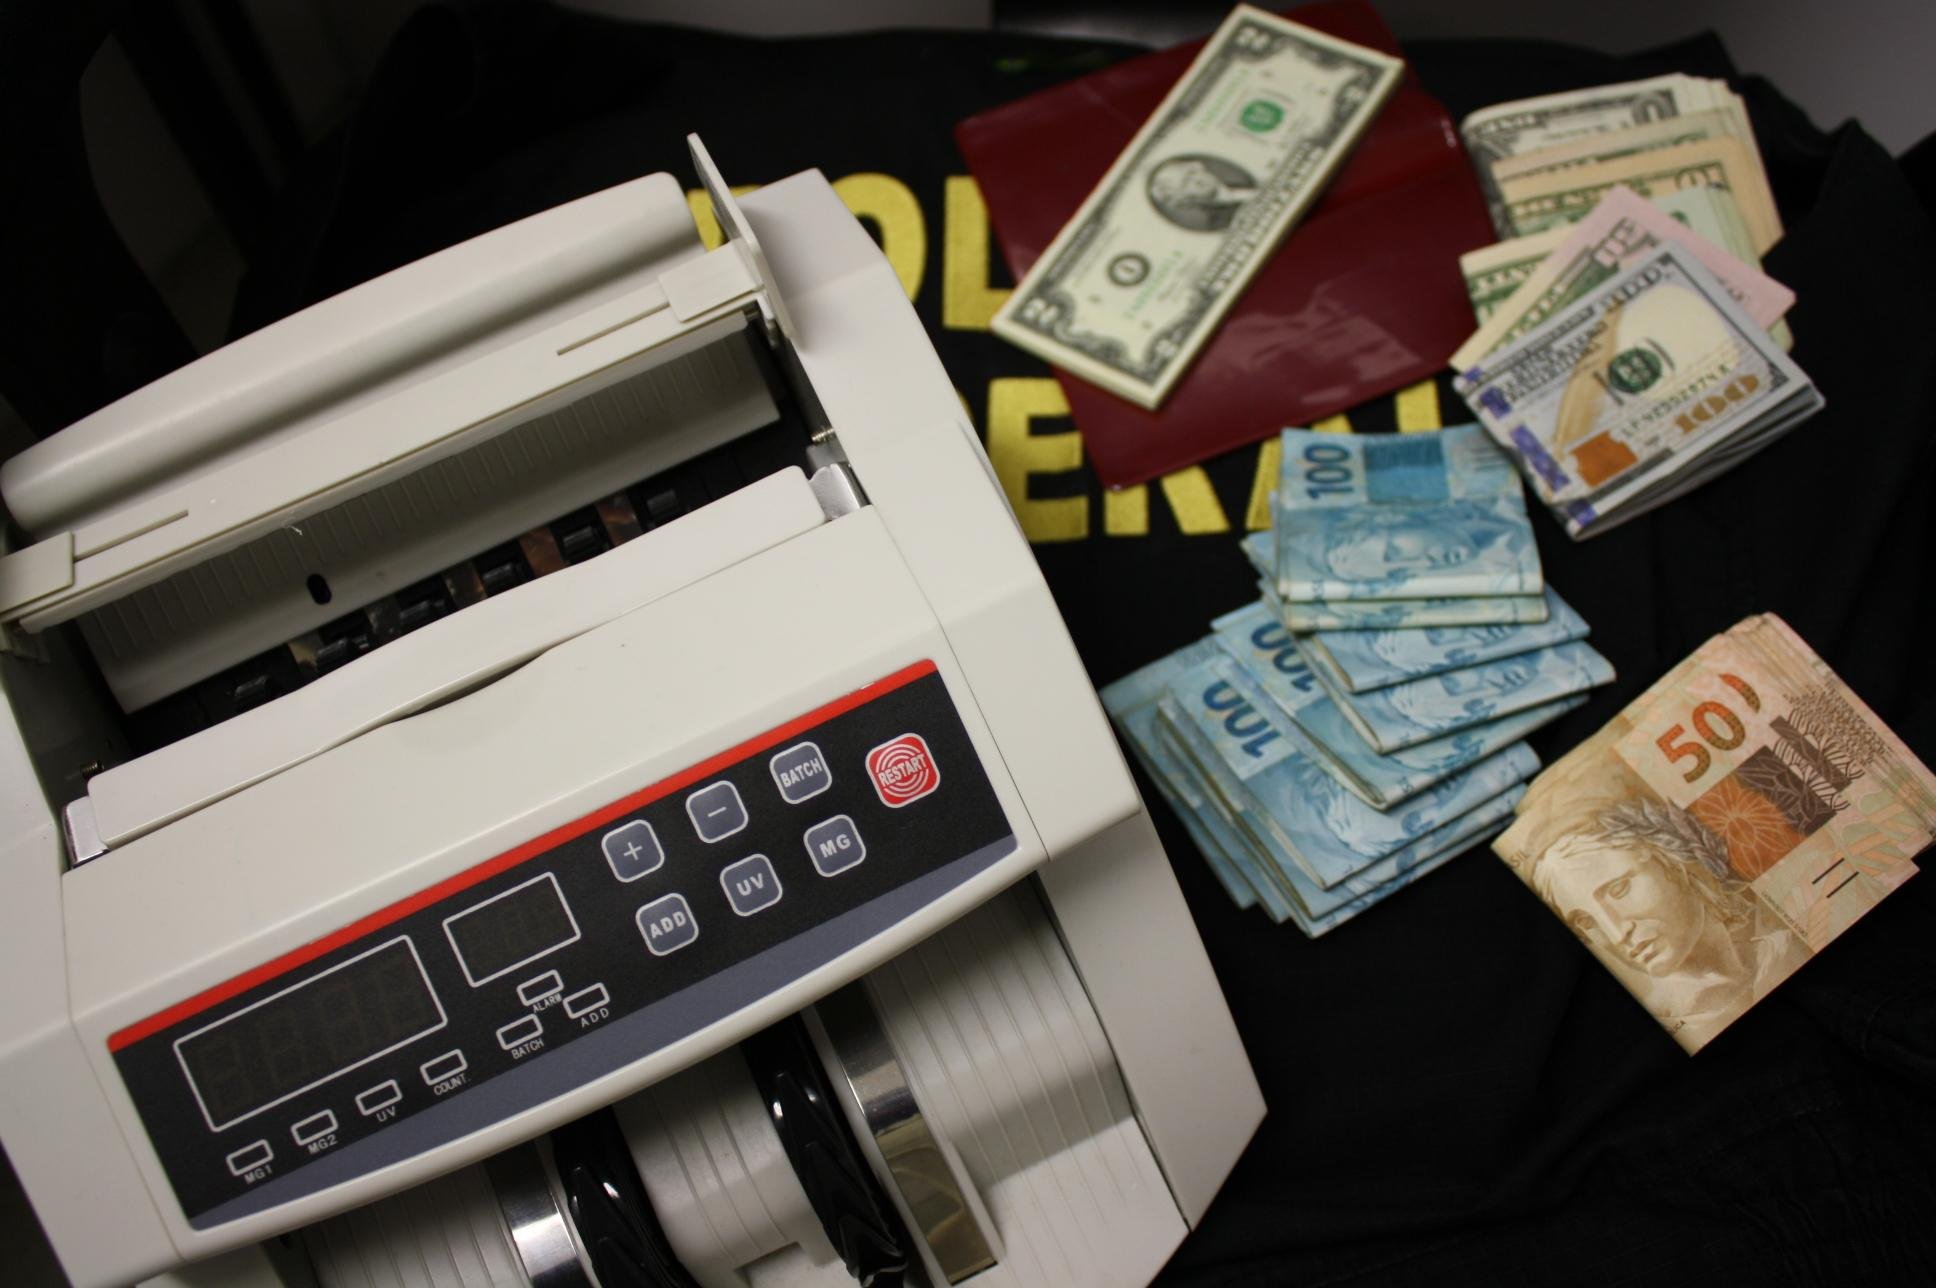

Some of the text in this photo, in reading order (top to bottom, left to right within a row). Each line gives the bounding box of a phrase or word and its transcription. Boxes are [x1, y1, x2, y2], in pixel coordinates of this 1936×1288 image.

[1673, 373, 1760, 436] 100
[1304, 443, 1354, 499] 100
[779, 757, 823, 788] BATCH
[877, 753, 927, 787] RESTART
[819, 833, 851, 858] MG
[736, 872, 764, 896] UV
[649, 911, 687, 939] ADD
[532, 992, 563, 1013] ALARM
[580, 1007, 610, 1029] ADD
[511, 1037, 545, 1060] BATCH
[376, 1105, 397, 1123] UV
[307, 1134, 339, 1155] MG2
[243, 1164, 273, 1185] MG1
